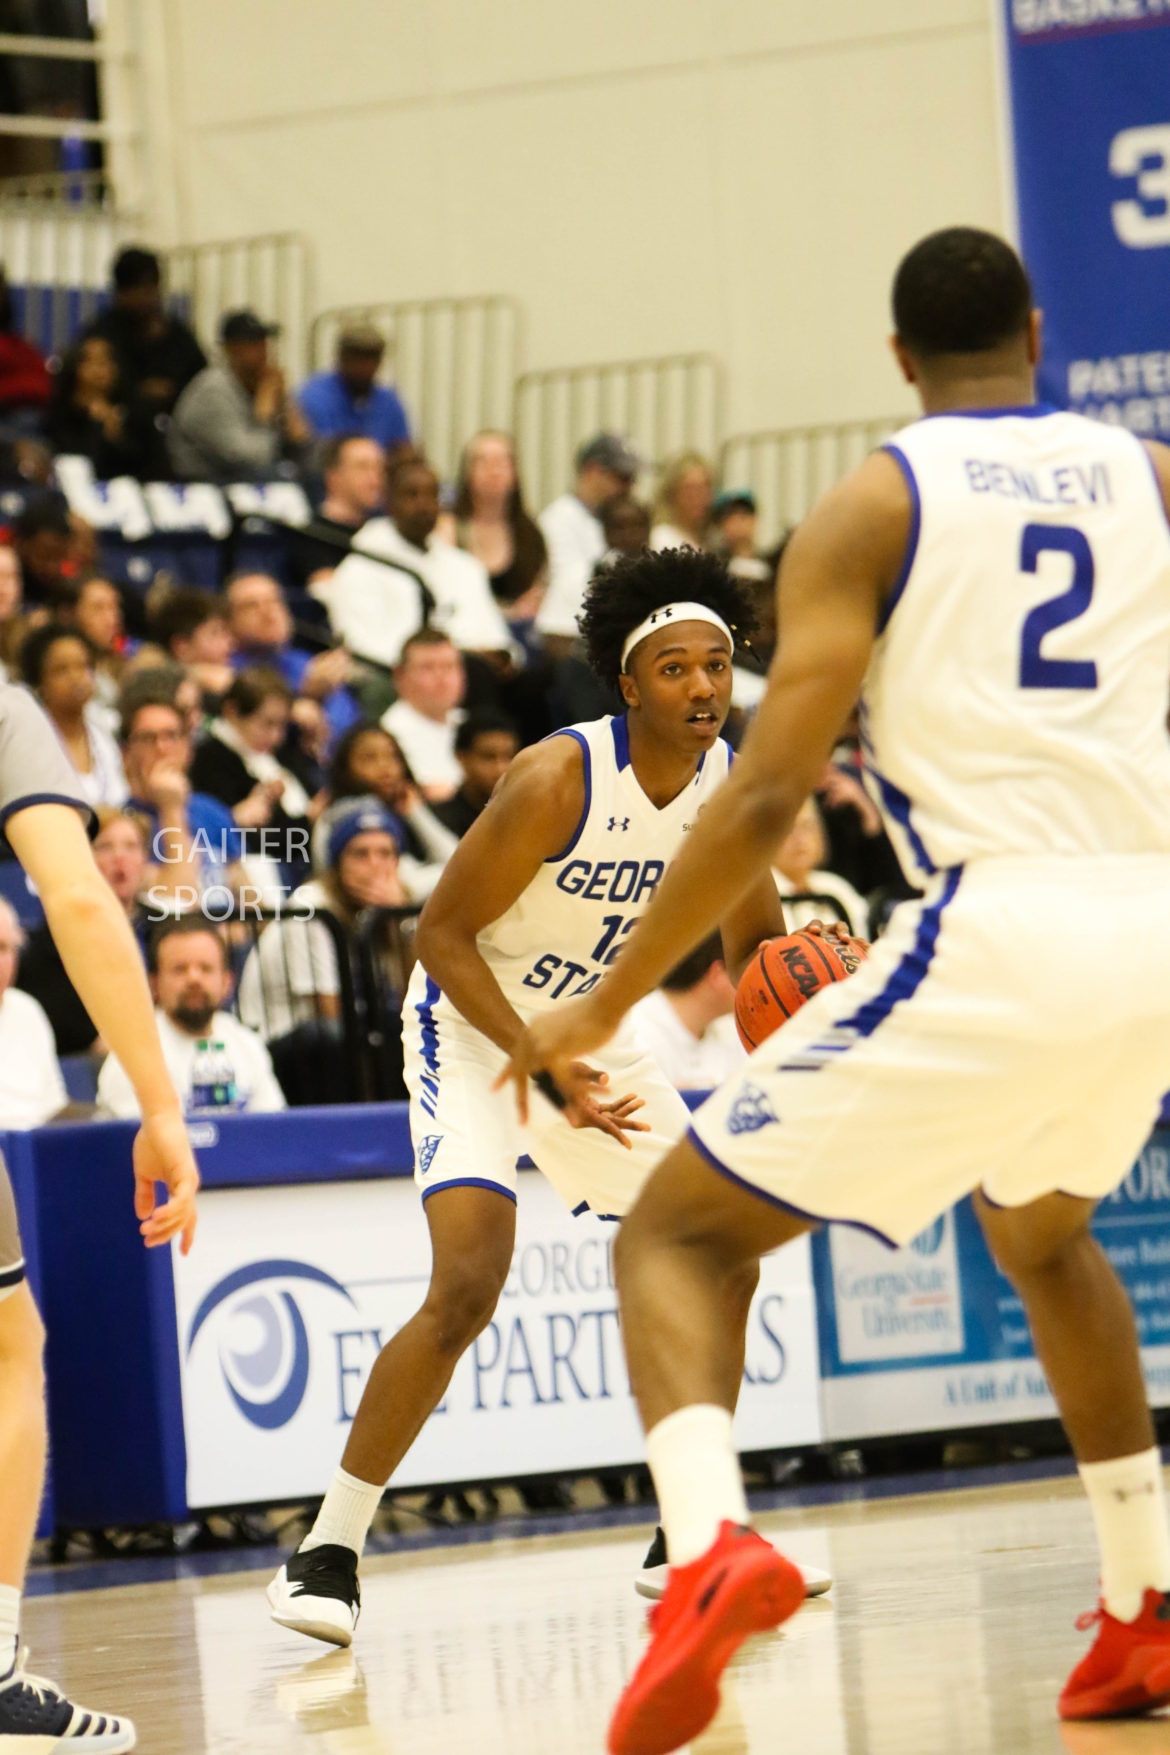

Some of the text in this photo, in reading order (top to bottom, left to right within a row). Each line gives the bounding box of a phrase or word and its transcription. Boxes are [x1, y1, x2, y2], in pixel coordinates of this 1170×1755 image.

[1108, 122, 1170, 249] 3
[964, 458, 1115, 504] BENLEVI
[1018, 522, 1098, 690] 2
[556, 859, 664, 903] GEOR
[1109, 1146, 1170, 1203] OR
[472, 1293, 787, 1411] PARTS
